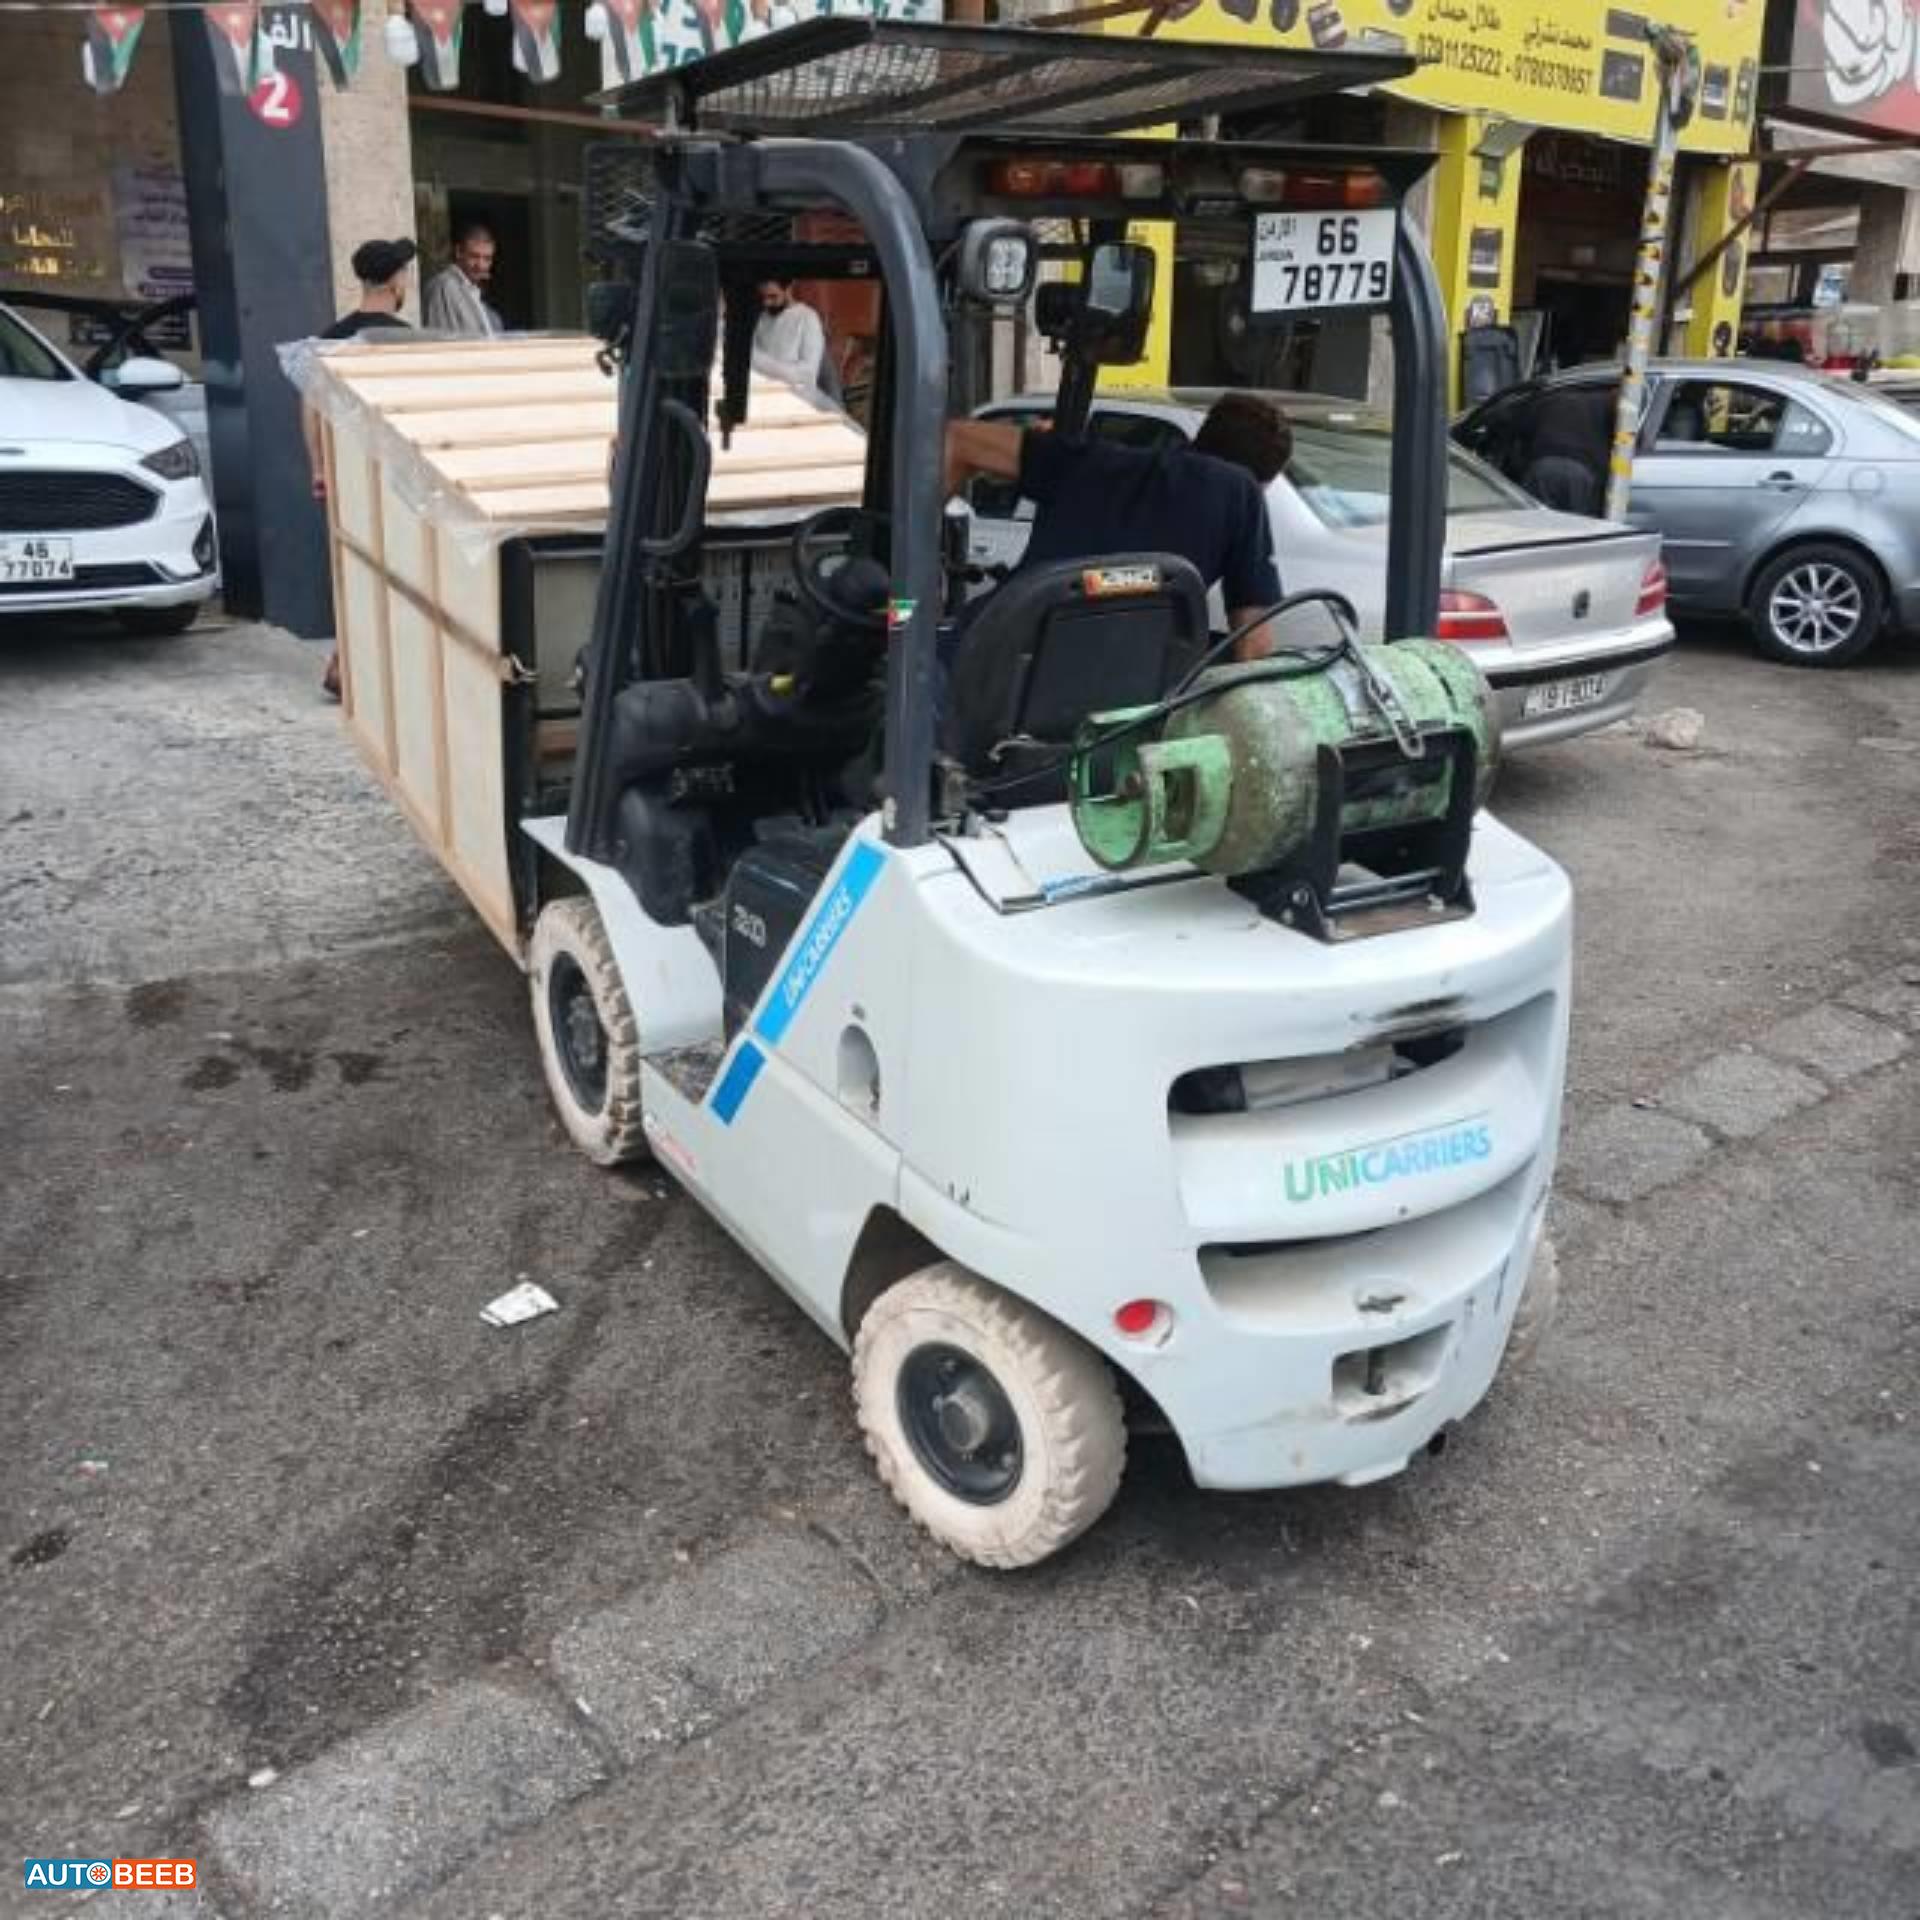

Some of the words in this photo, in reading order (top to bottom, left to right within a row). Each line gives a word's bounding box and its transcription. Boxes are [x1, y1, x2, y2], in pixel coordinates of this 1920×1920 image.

[261, 71, 290, 119] 2
[1317, 217, 1359, 255] 66
[1282, 261, 1388, 303] 78779
[1284, 1124, 1492, 1203] UNICARRIERS
